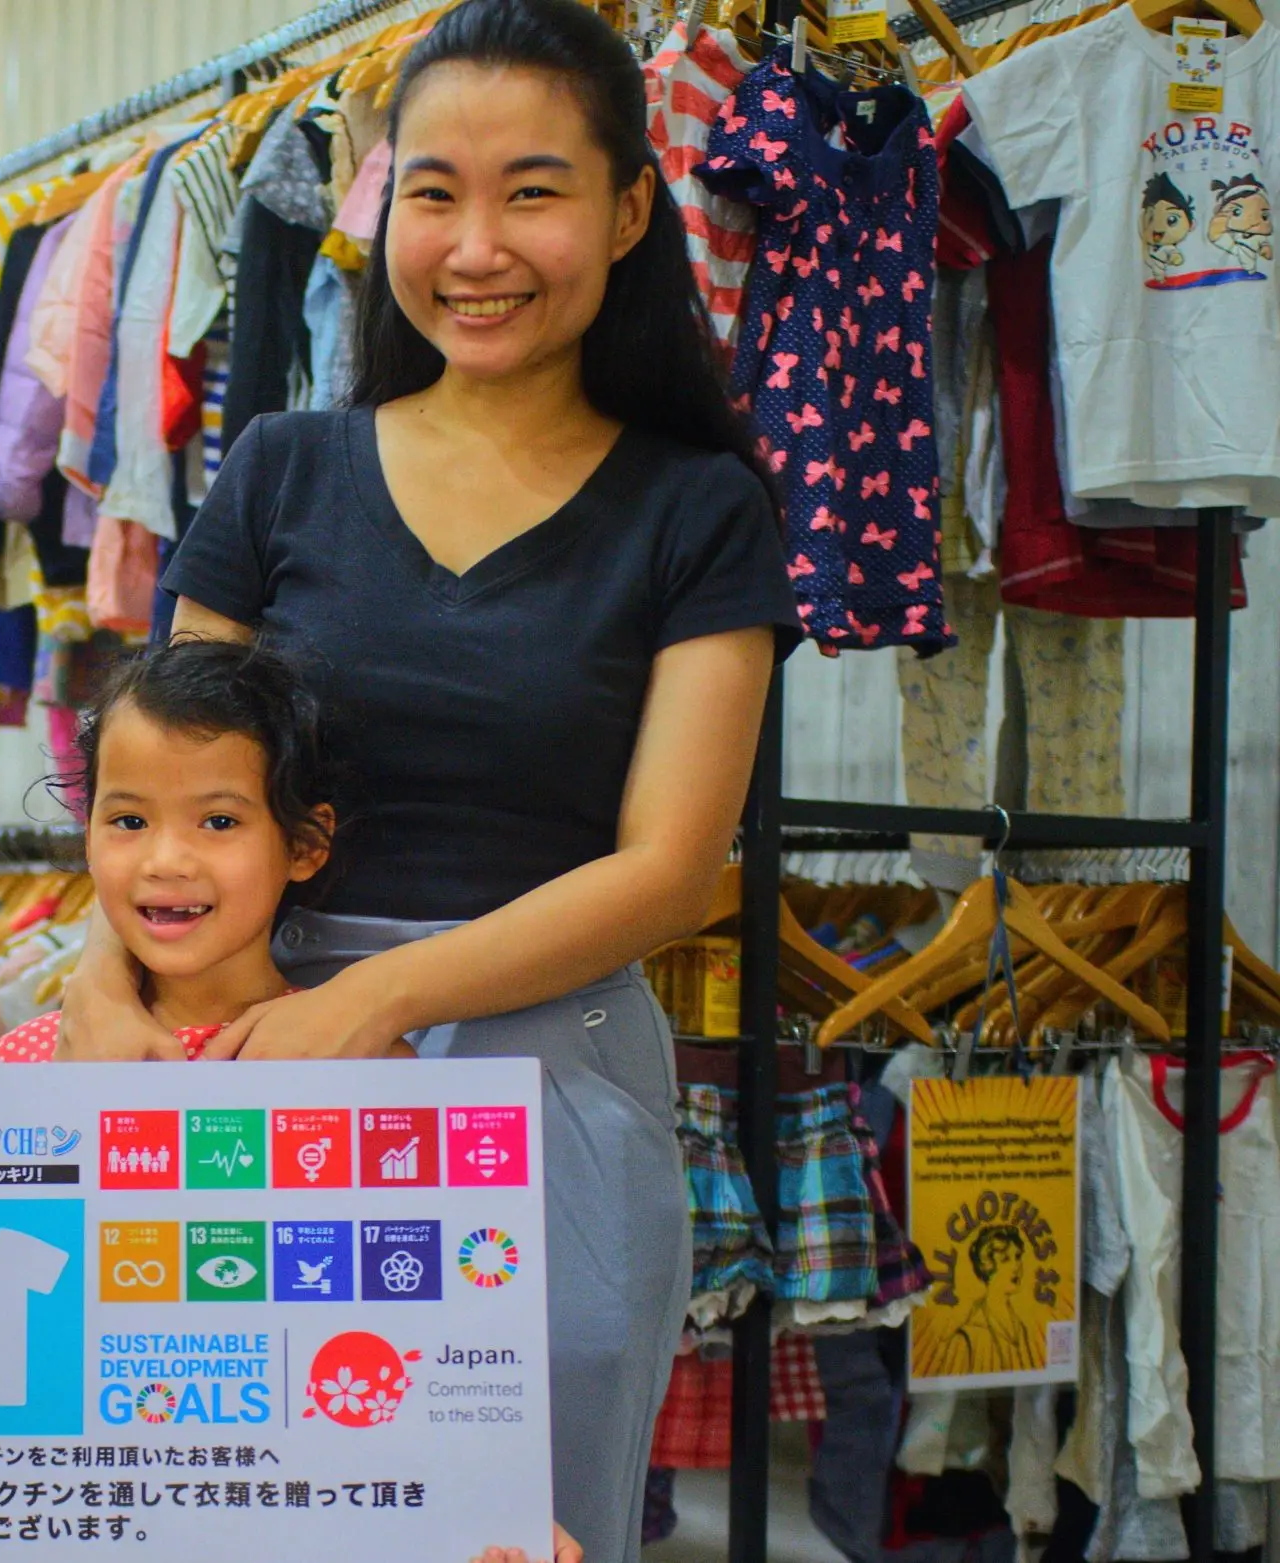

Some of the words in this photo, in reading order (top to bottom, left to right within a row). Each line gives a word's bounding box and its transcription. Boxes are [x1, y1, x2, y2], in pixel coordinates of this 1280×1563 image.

[1162, 142, 1250, 160] TAEKWONDO
[104, 1116, 112, 1134] 1
[190, 1115, 201, 1133] 3
[276, 1114, 287, 1133] 5
[363, 1113, 375, 1132] 8
[449, 1112, 468, 1131] 10
[104, 1228, 120, 1245] 12
[189, 1227, 207, 1245] 13
[276, 1227, 294, 1245] 16
[363, 1226, 381, 1244] 17
[933, 1247, 959, 1307] ALL
[946, 1190, 1058, 1263] CLOTHES
[99, 1333, 269, 1354] SUSTAINABLE
[436, 1343, 523, 1370] Japan.
[99, 1358, 269, 1378] DEVELOPMENT
[427, 1381, 523, 1397] Committed
[99, 1381, 272, 1425] GOALS
[429, 1409, 445, 1423] to
[448, 1407, 475, 1423] the
[477, 1406, 523, 1424] SDGs
